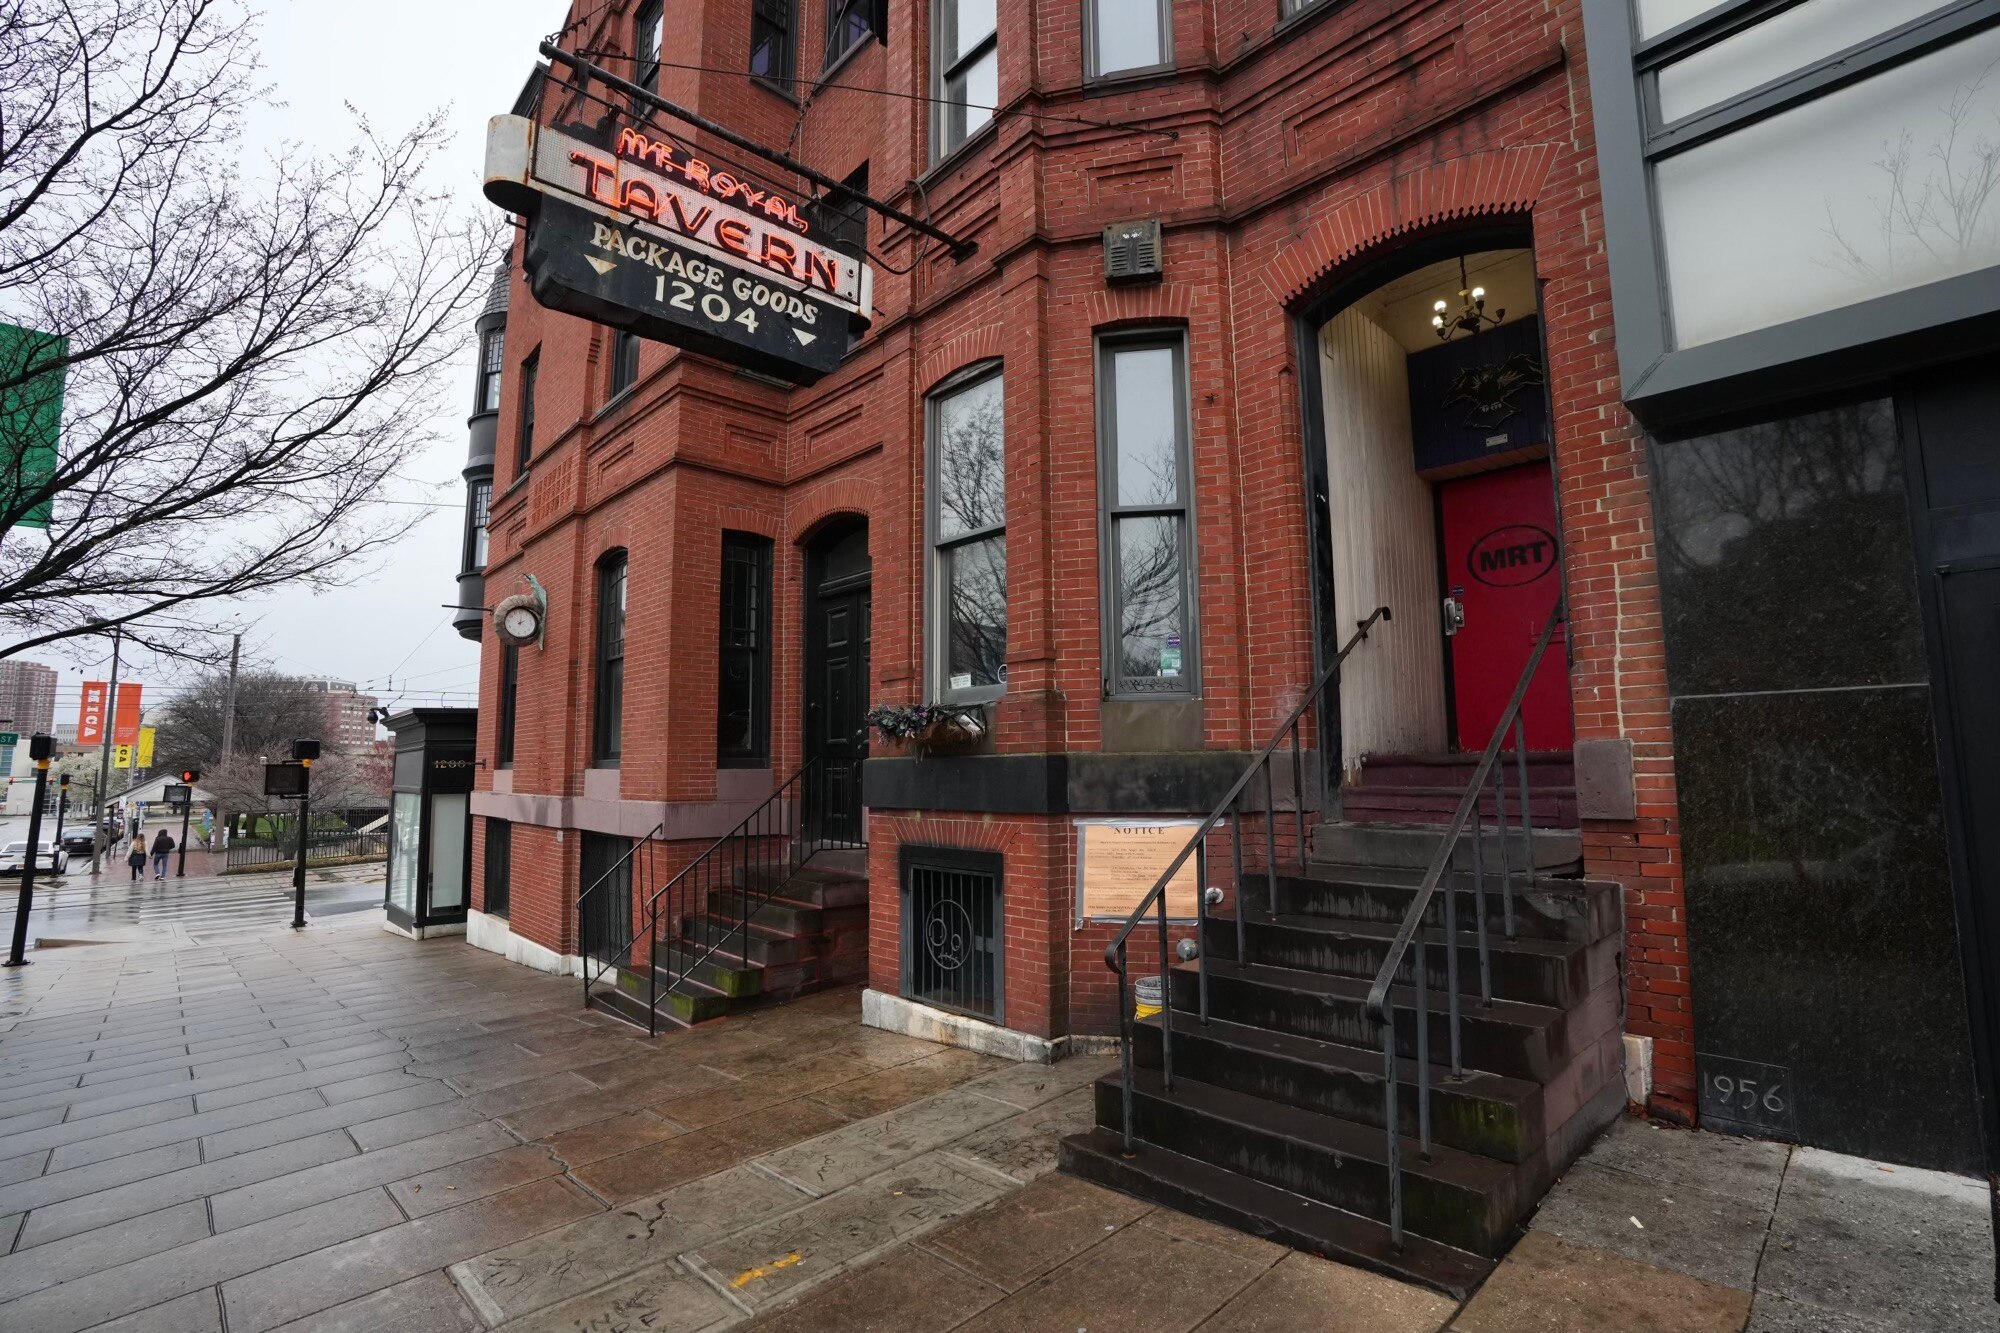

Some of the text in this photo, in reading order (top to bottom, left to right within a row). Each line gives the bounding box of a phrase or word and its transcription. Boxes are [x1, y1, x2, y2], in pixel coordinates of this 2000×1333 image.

[568, 151, 839, 294] TAVERN
[685, 158, 809, 234] ROYAL
[589, 221, 819, 325] PACKAGE GOODS
[655, 274, 760, 334] 1204
[1480, 541, 1547, 572] MRT
[84, 690, 100, 737] MICA
[1703, 1071, 1784, 1112] 1956
